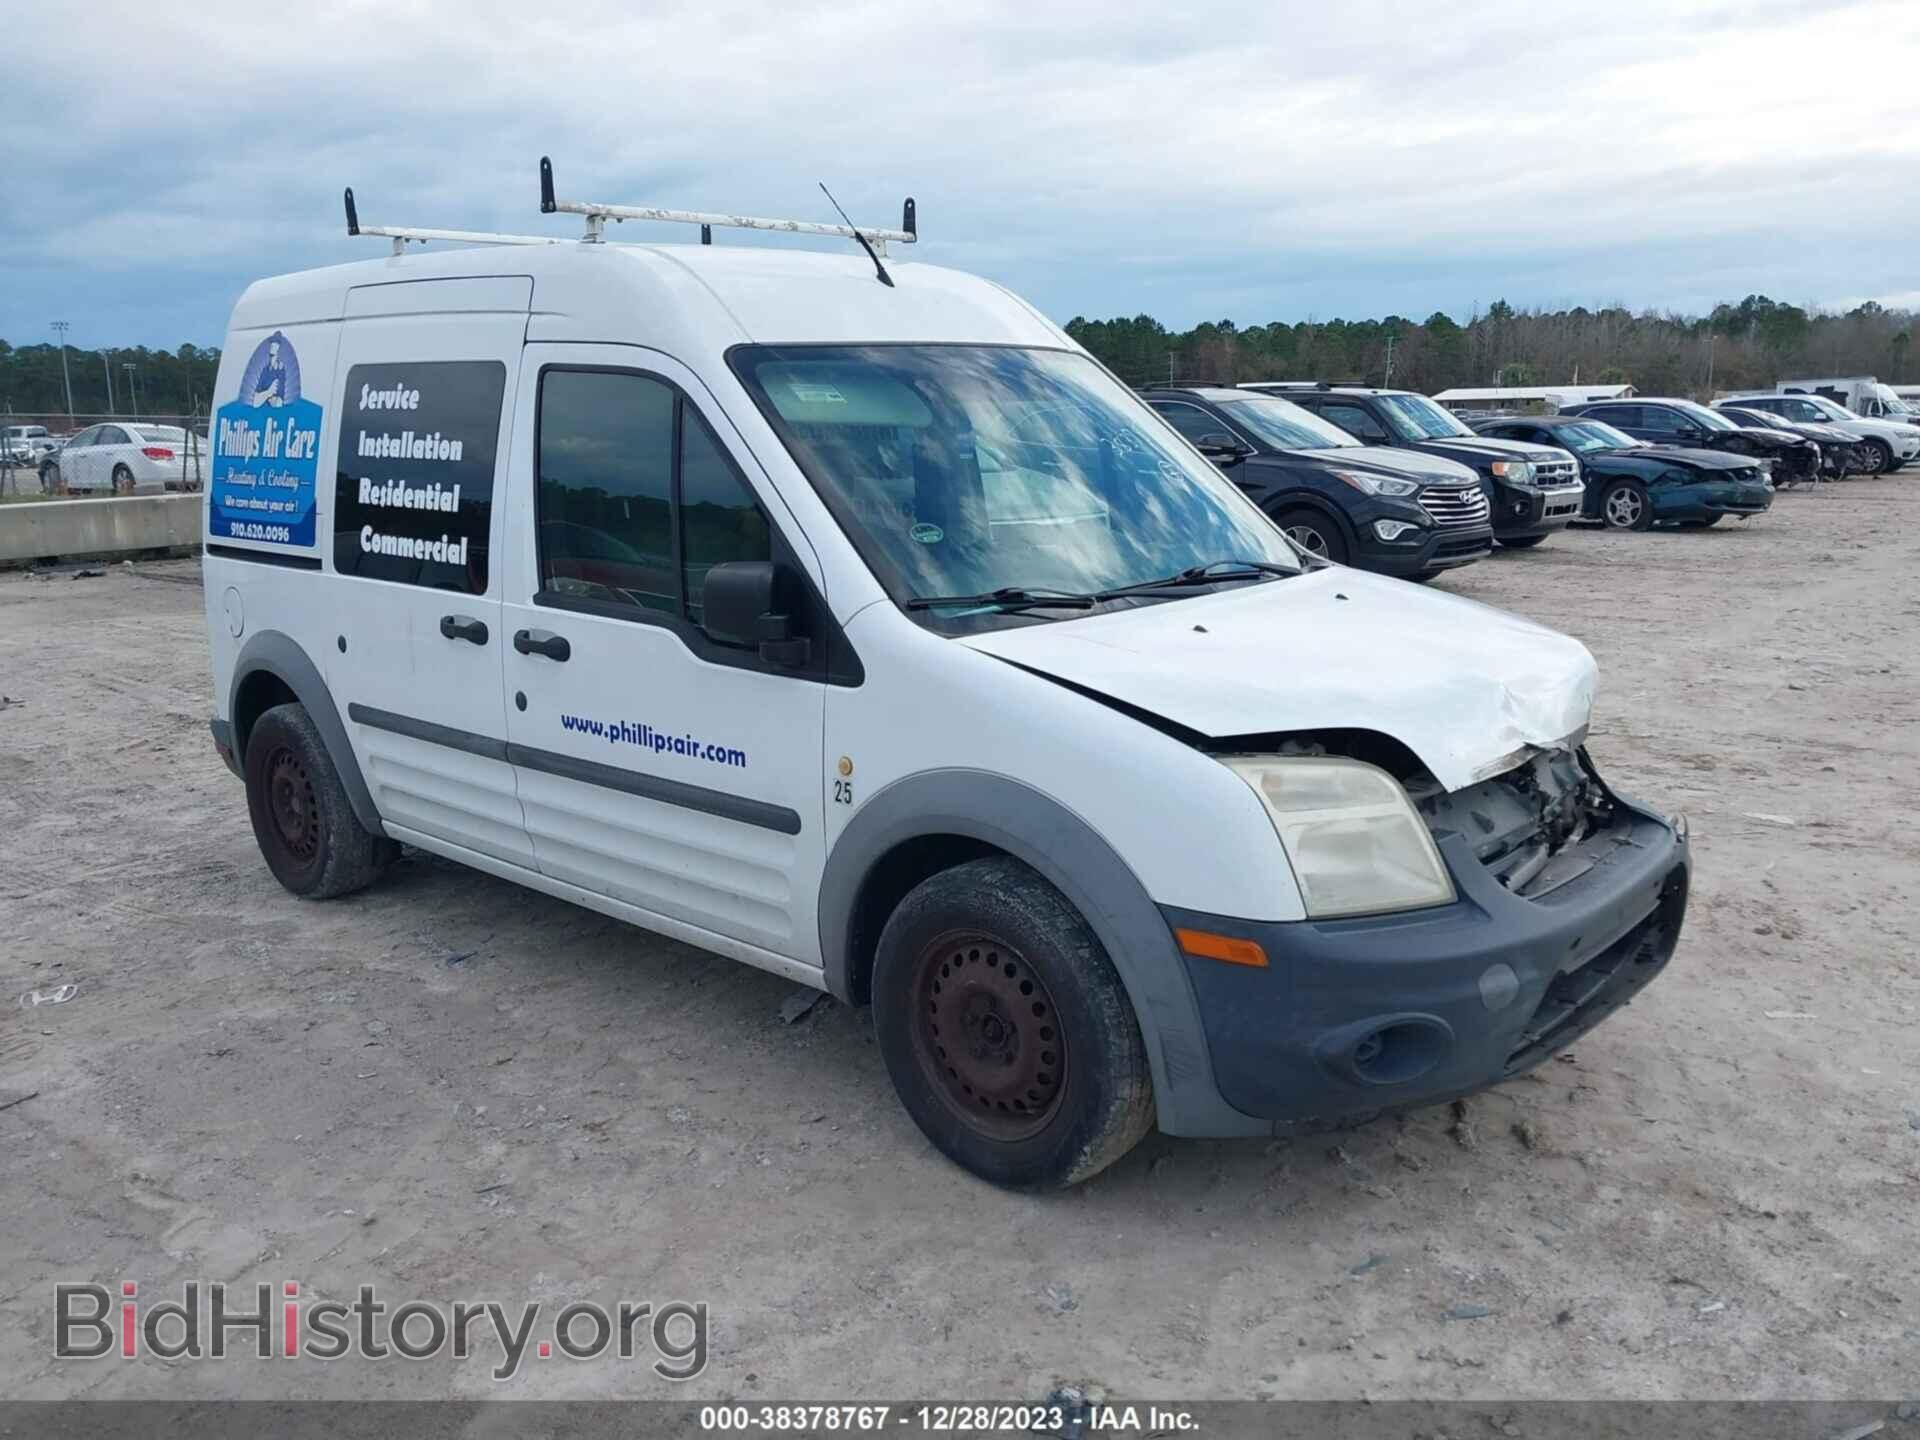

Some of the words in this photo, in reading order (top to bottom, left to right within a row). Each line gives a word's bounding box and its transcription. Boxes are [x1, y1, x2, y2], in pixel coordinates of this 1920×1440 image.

[359, 383, 420, 410] Service
[218, 417, 260, 464] Phillips
[263, 417, 284, 458] Air
[285, 417, 316, 459] Care
[358, 430, 463, 461] Installation
[226, 467, 257, 489] Heating
[258, 469, 267, 486] &
[268, 469, 299, 492] Cooling
[225, 495, 236, 507] We
[250, 499, 269, 510] about
[270, 500, 284, 513] your
[358, 477, 461, 513] Residential
[230, 521, 290, 543] 910.620.0096
[360, 524, 468, 566] Commercial
[561, 714, 747, 768] www.phillipsair.com
[835, 781, 852, 804] 25
